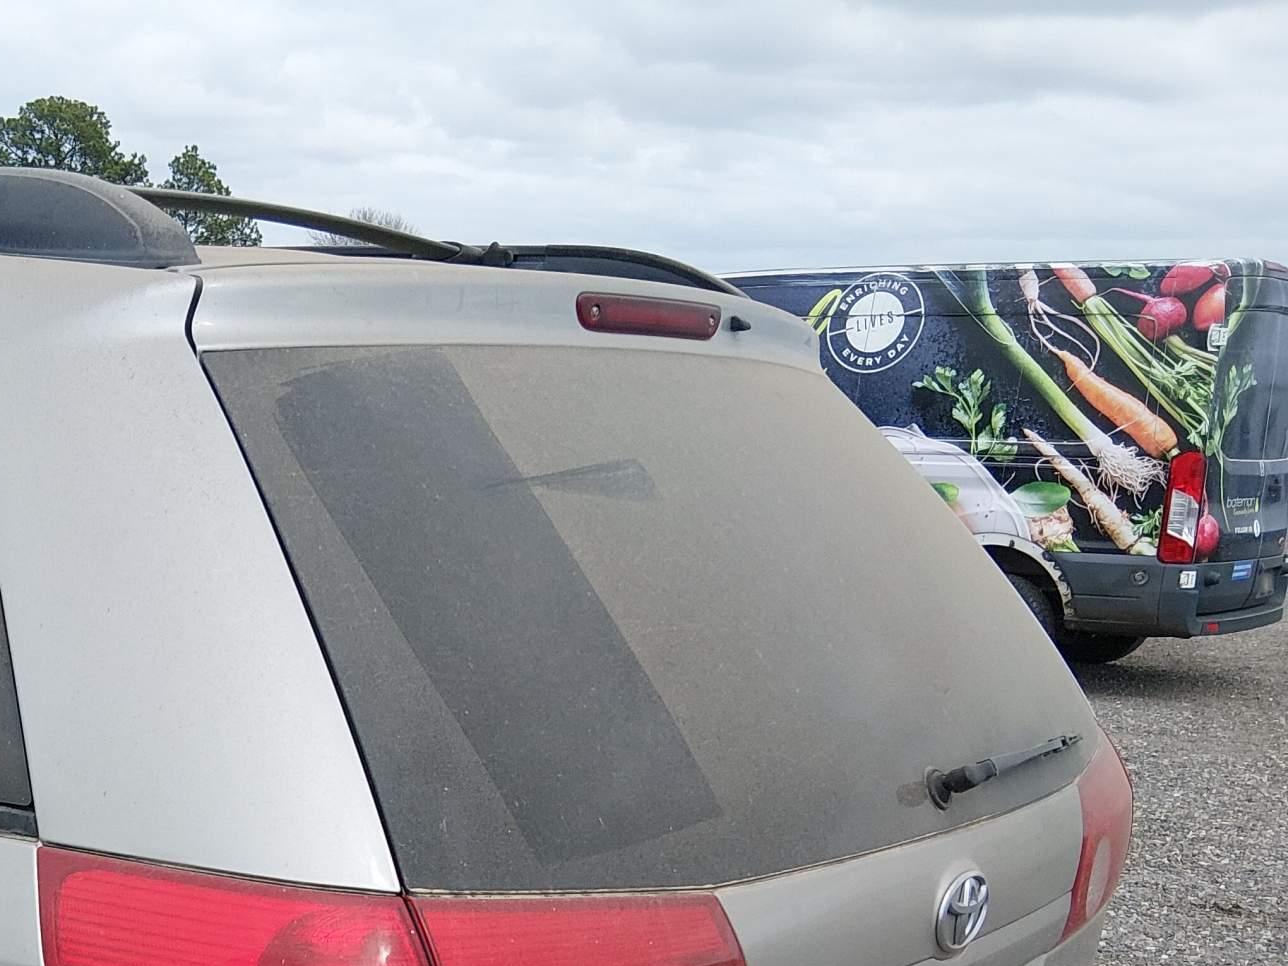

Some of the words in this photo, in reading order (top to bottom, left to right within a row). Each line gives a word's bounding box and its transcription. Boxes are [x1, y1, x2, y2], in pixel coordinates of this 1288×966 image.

[839, 279, 909, 311] ENRICHING
[856, 311, 894, 332] LIVES
[842, 347, 882, 366] EVERY
[887, 334, 909, 358] DAY
